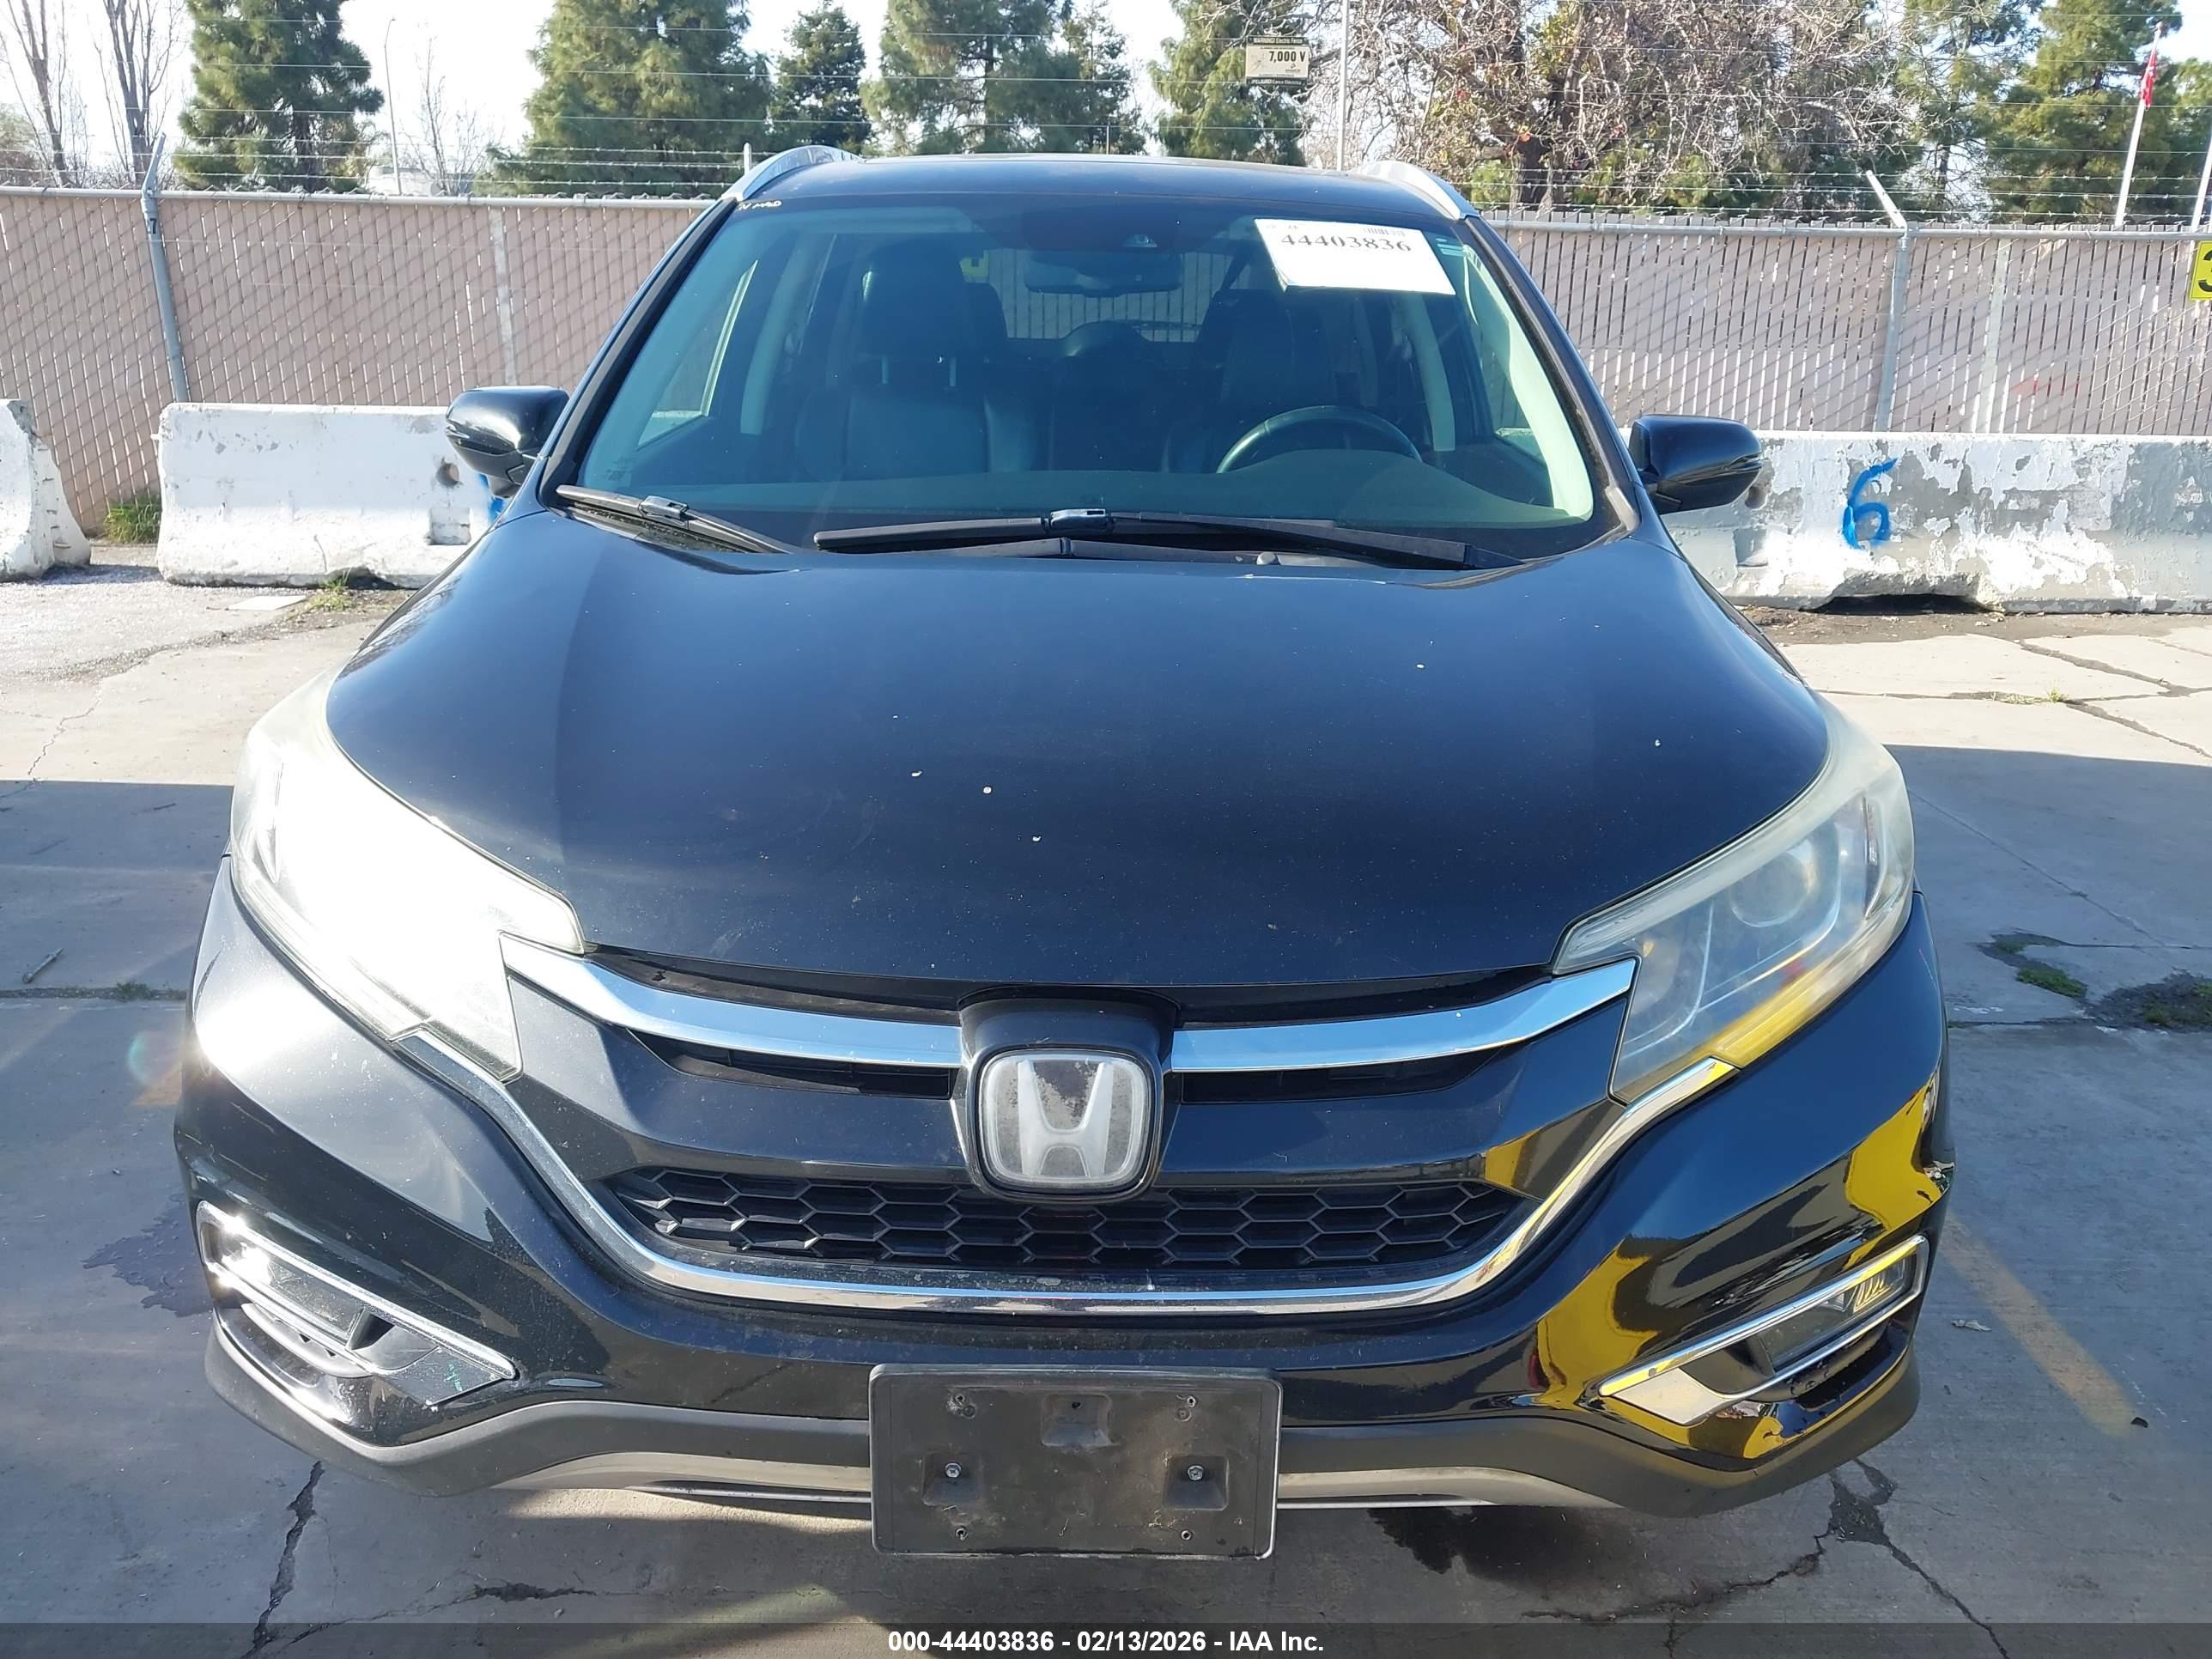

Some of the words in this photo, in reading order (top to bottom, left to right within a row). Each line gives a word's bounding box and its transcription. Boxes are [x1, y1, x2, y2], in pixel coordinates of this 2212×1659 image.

[1269, 51, 1297, 63] 7,000
[1299, 51, 1306, 62] V
[1280, 234, 1412, 252] 44403836
[1842, 458, 1899, 550] 6
